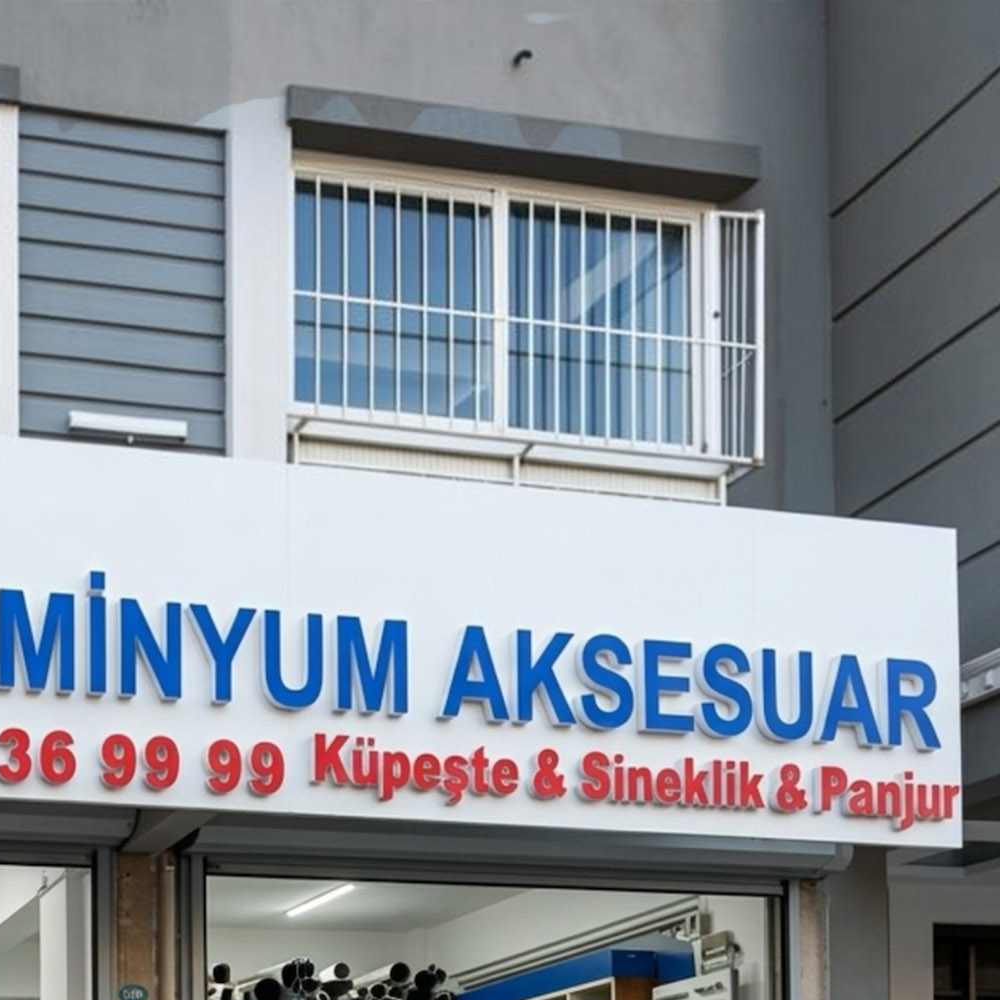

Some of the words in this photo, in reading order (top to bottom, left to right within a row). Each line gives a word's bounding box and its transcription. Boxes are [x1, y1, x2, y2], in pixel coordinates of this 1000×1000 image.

[440, 625, 939, 748] AKSESUAR
[101, 734, 179, 787] 99
[208, 739, 284, 792] 99
[314, 733, 518, 804] Küpeşte
[533, 749, 566, 796] &
[582, 752, 763, 808] Sineklik
[777, 764, 805, 810] &
[820, 766, 961, 831] Panjur
